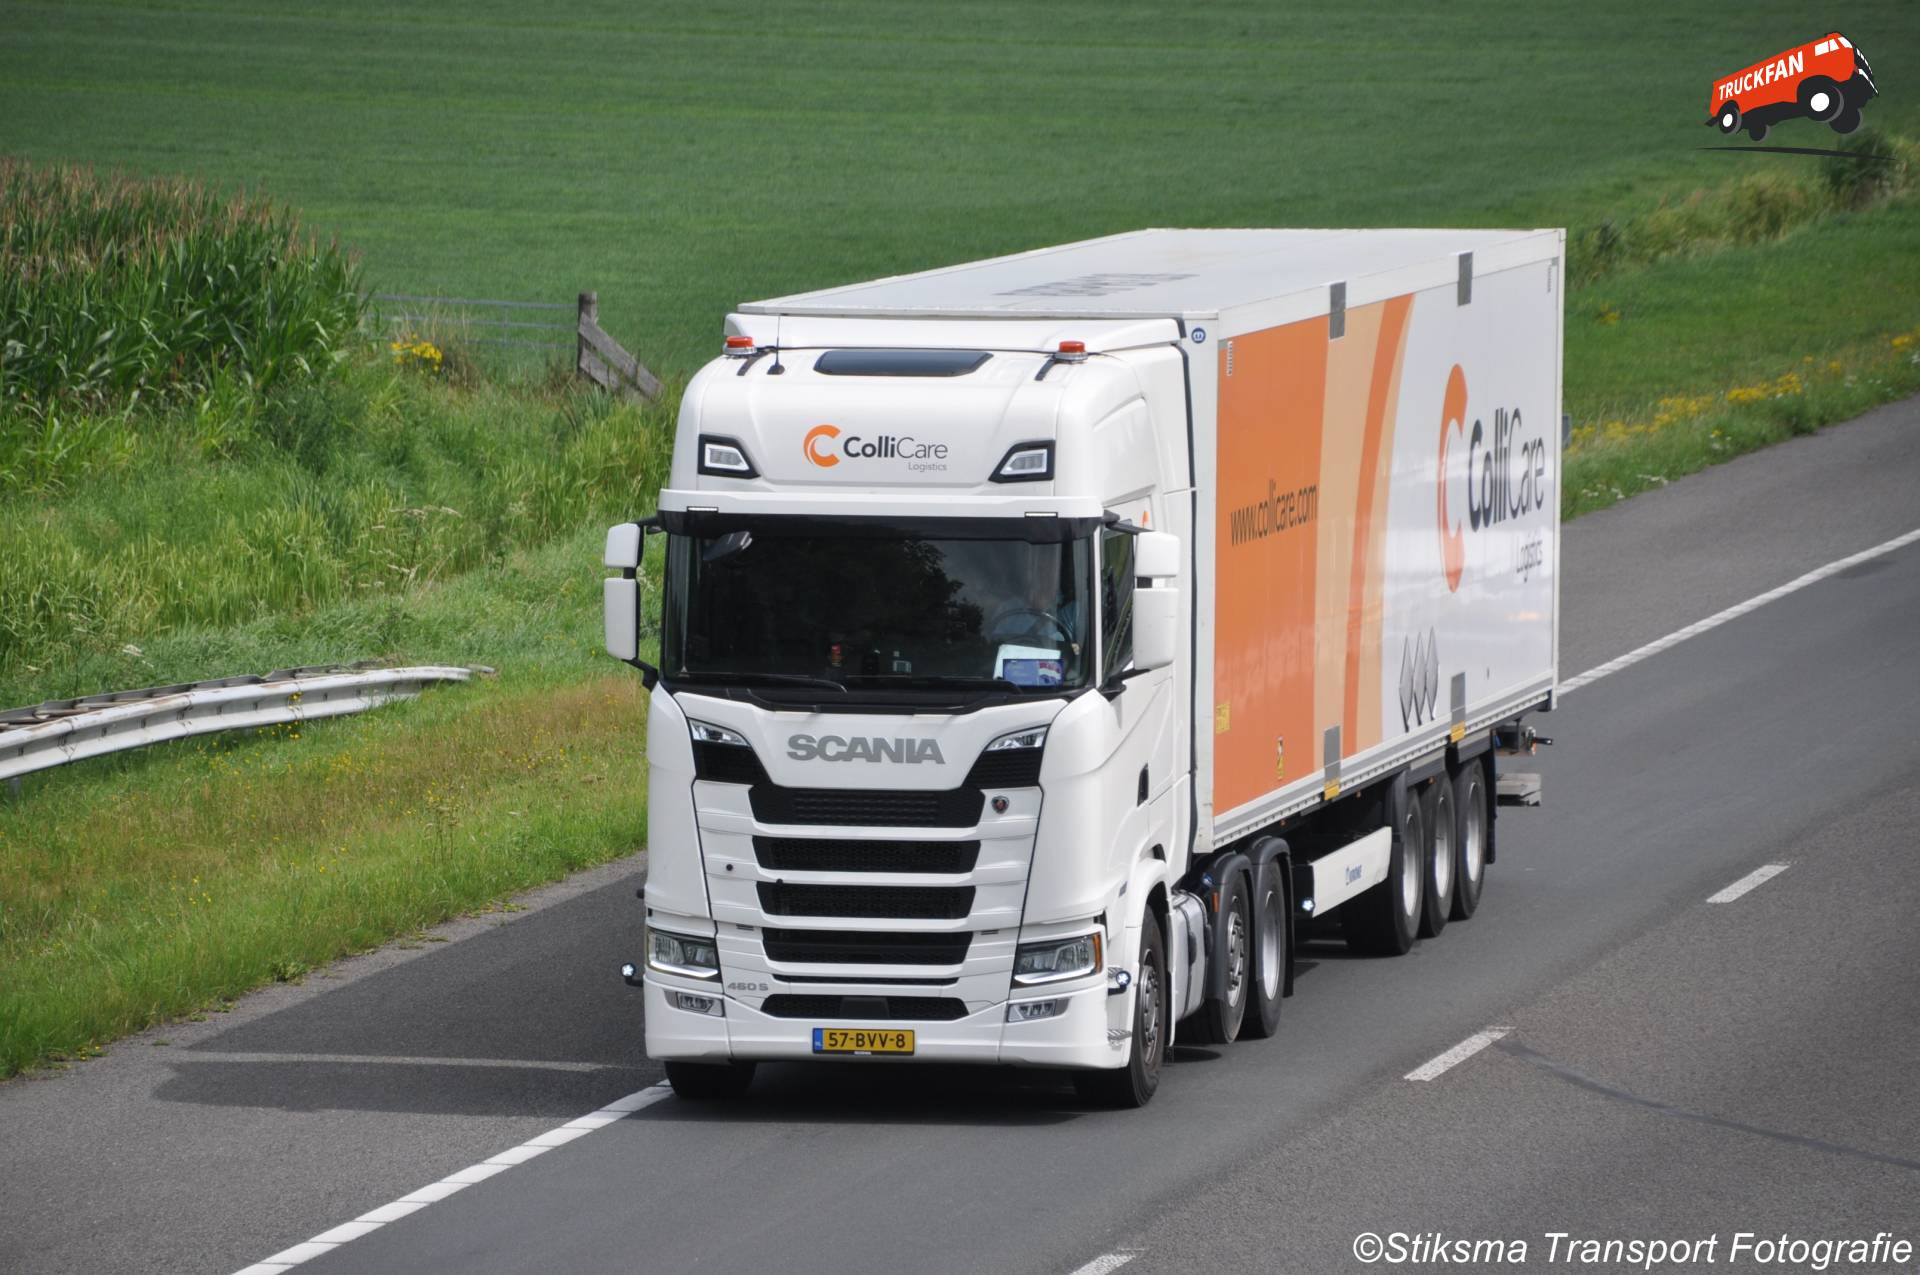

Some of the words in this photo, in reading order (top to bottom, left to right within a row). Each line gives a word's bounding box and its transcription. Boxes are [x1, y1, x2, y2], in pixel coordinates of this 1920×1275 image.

[843, 436, 948, 459] ColliCare
[908, 462, 948, 472] Logistics
[1468, 407, 1545, 532] ColliCare
[1231, 479, 1317, 547] www.collicare.com
[786, 734, 946, 764] SCANIA
[828, 1032, 906, 1048] 57-BVV-8
